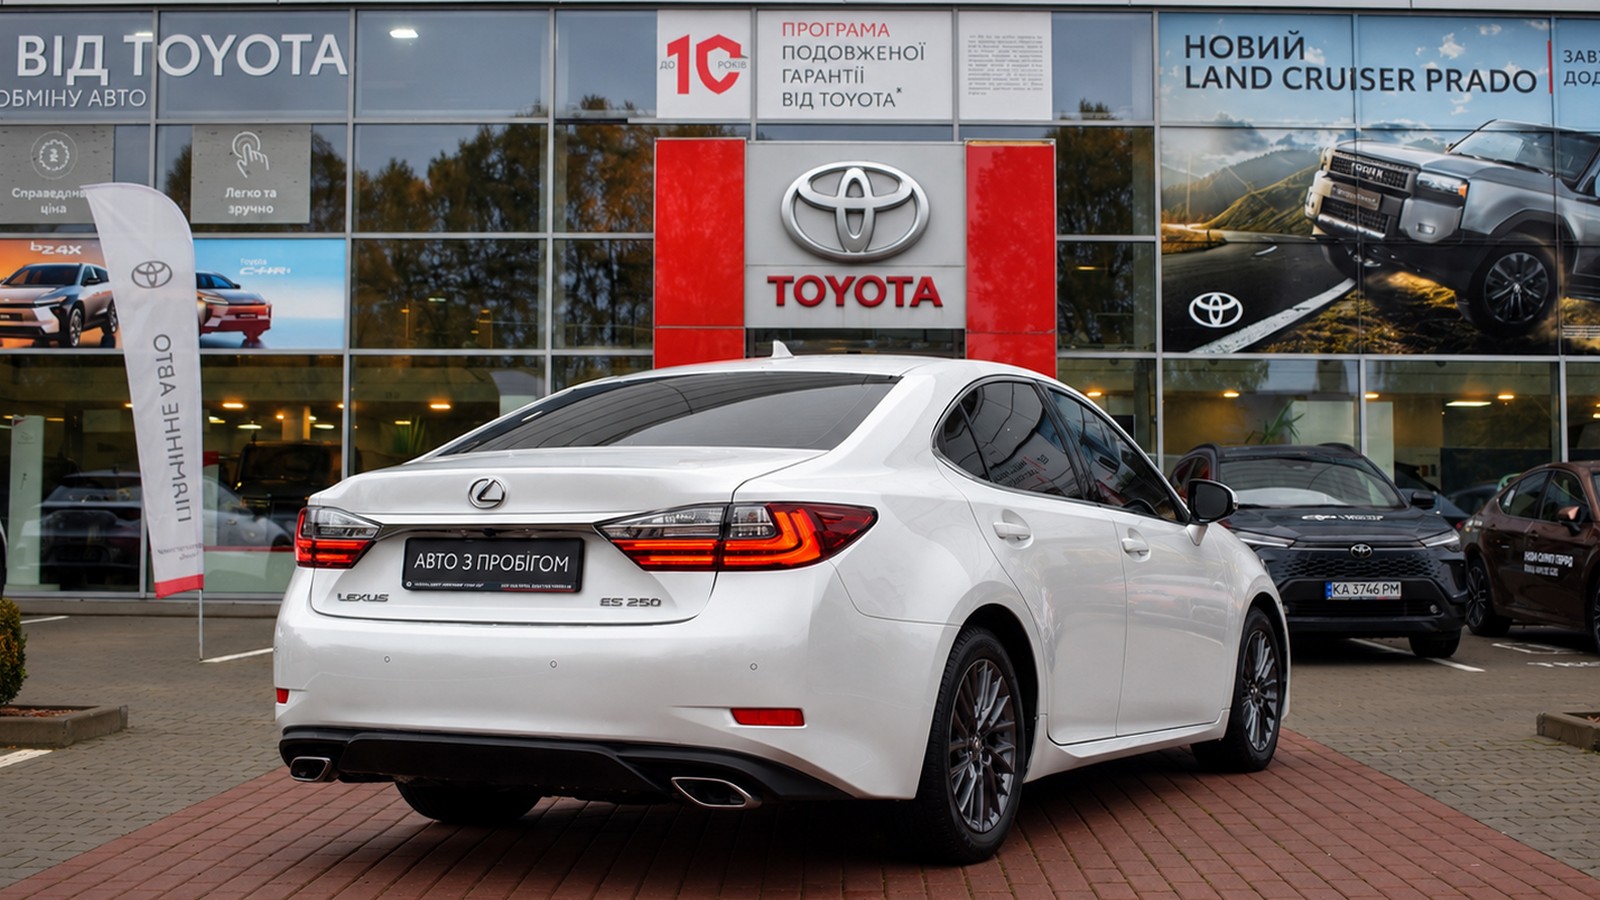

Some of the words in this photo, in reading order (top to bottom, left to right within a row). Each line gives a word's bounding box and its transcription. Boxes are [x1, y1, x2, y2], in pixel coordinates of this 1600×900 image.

[782, 22, 891, 38] ПРОГРАМА
[782, 42, 927, 63] ПОДОВЖЕНОЇ
[1185, 30, 1305, 61] НОВИЙ
[17, 35, 109, 86] ВІД
[123, 33, 349, 77] TOYOTA
[1563, 49, 1600, 64] ЗАВ
[659, 60, 676, 70] ДО
[717, 60, 747, 69] РОКІВ
[782, 66, 865, 84] ГАРАНТІЇ
[1185, 65, 1273, 90] LAND
[1282, 66, 1416, 92] CRUISER
[1426, 68, 1538, 94] PRADO
[0, 89, 82, 108] ОБМІНУ
[87, 89, 147, 107] АВТО
[782, 92, 815, 109] ВІД
[12, 187, 87, 200] Справедлив
[225, 187, 262, 198] Легко
[263, 189, 277, 198] та
[41, 203, 67, 215] ціна
[228, 205, 274, 216] зручно
[767, 274, 944, 308] TOYOTA
[413, 552, 458, 571] АВТО
[461, 553, 473, 571] З
[476, 550, 570, 573] ПРОБІГОМ
[1333, 583, 1350, 595] KA
[1352, 583, 1380, 595] 3746
[1382, 583, 1400, 595] PM
[337, 593, 390, 603] LEXUS
[600, 597, 624, 607] ES
[626, 598, 662, 607] 250
